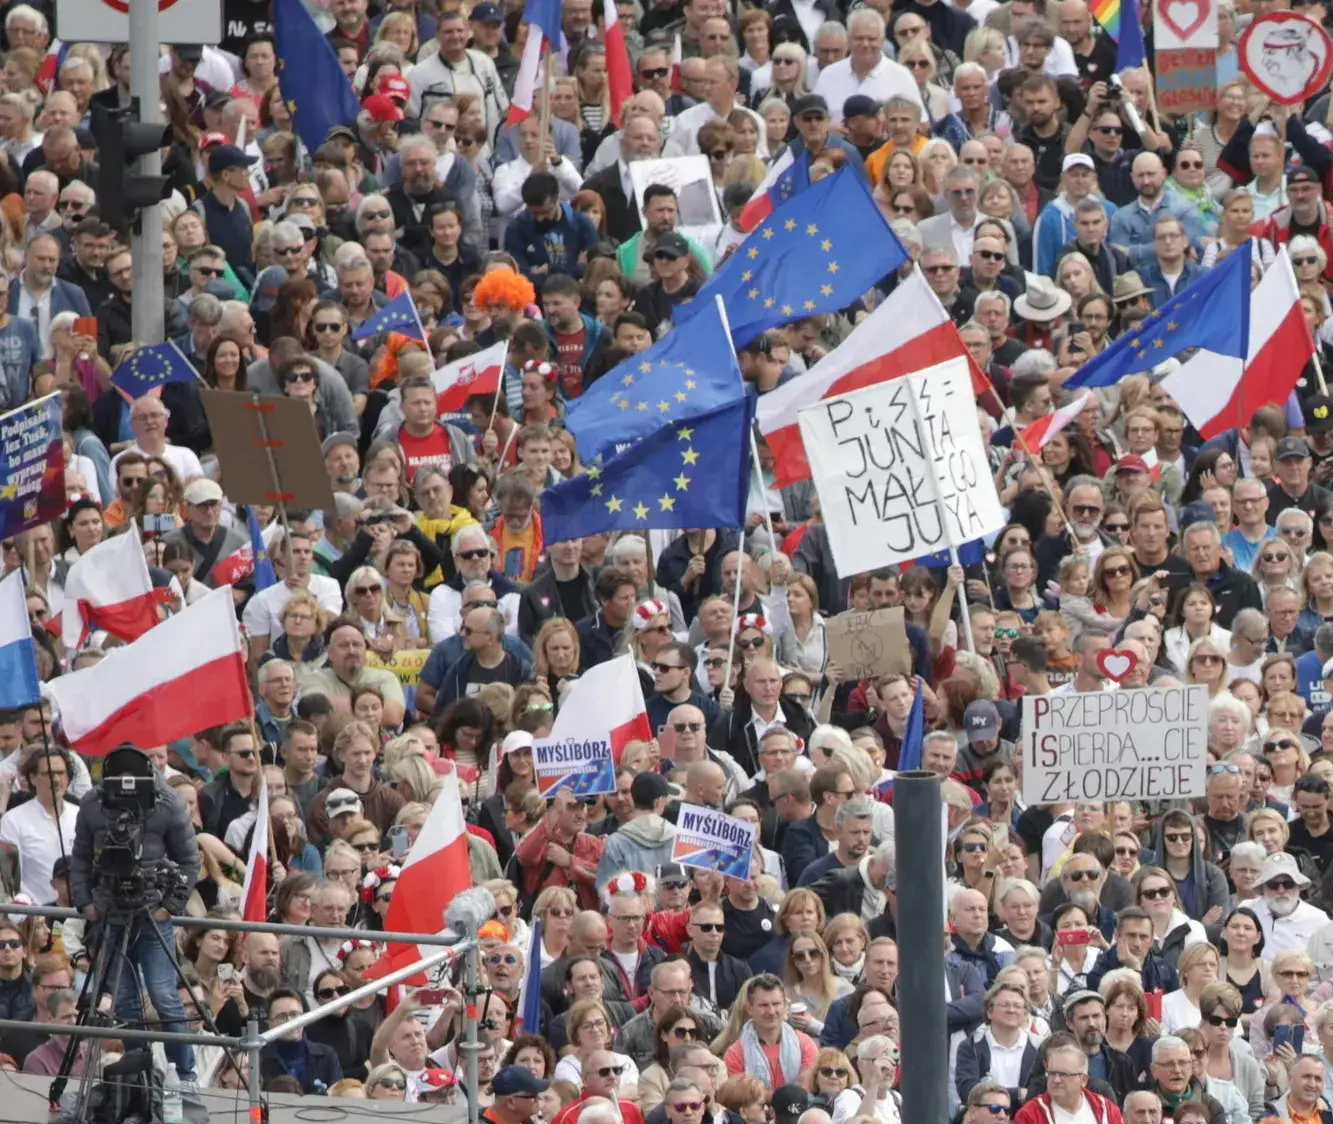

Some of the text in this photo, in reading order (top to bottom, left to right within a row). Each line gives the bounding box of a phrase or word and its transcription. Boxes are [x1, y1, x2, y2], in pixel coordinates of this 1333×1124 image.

[845, 449, 977, 526] MAŁEGO
[972, 715, 987, 726] NY
[1034, 687, 1201, 729] PRZEPROŚCIE
[537, 739, 608, 764] MYŚLIBÓRZ
[1041, 764, 1193, 801] ZŁODZIEJE
[682, 810, 752, 849] MYŚLIBÓRZ
